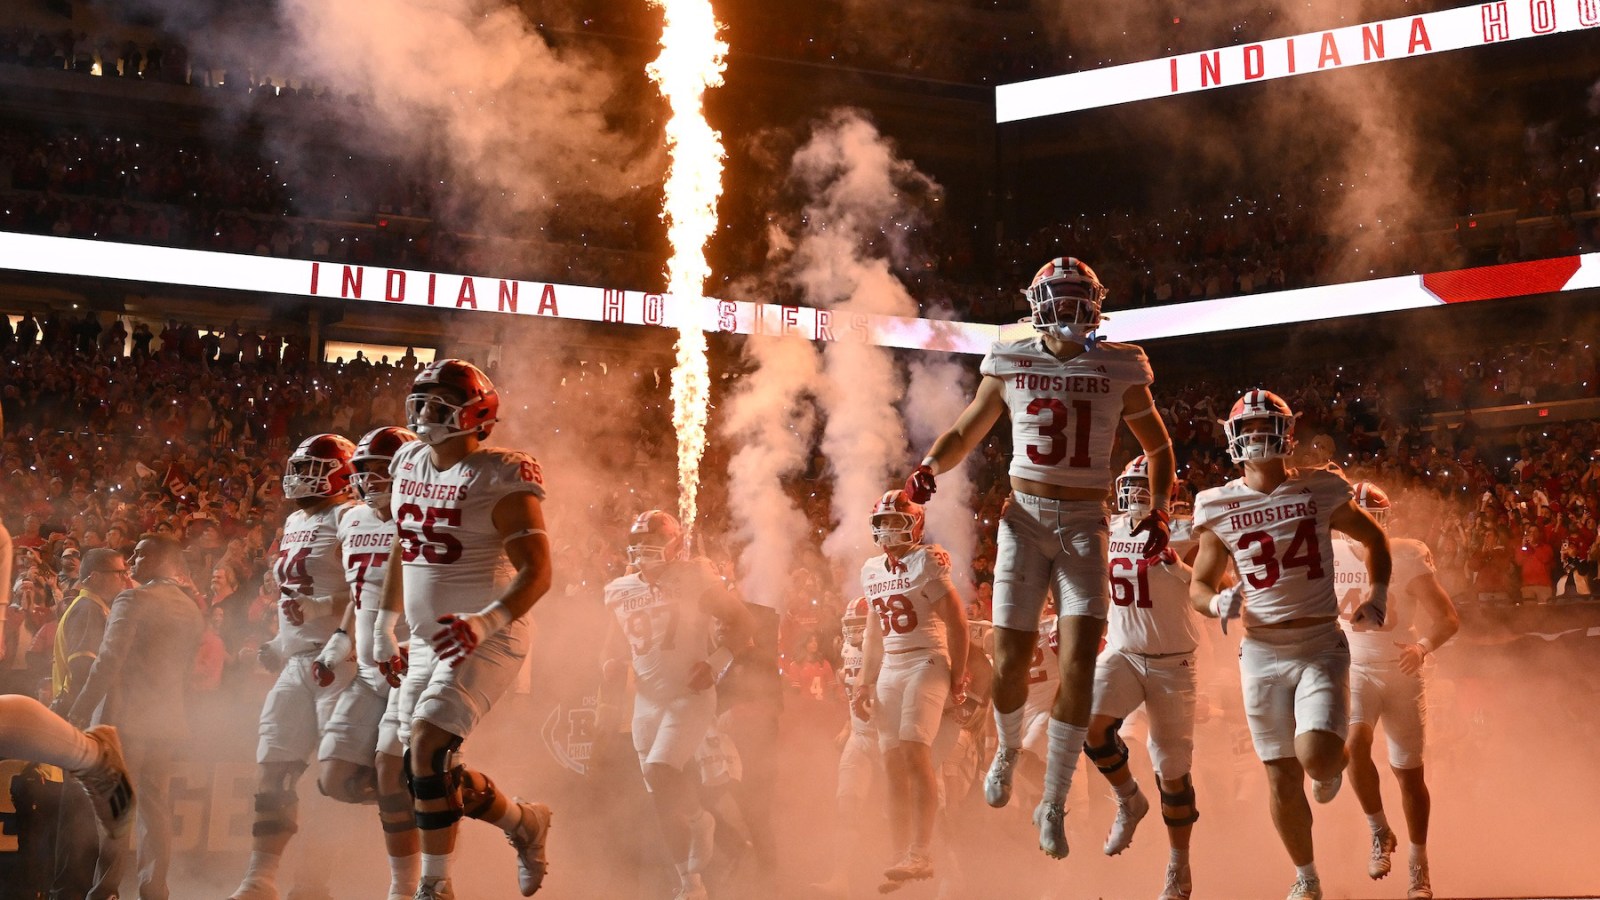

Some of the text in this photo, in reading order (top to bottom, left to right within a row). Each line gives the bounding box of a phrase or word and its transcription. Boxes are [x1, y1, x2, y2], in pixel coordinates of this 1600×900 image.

[1169, 17, 1432, 93] INDIANA
[310, 262, 869, 343] INDIANA HOSIERS
[1015, 373, 1111, 393] HOOSIERS
[1026, 397, 1092, 468] 31
[519, 460, 543, 485] 65
[399, 478, 468, 501] HOOSIERS
[1230, 500, 1318, 531] HOOSIERS
[350, 533, 394, 548] HOOSIE
[397, 503, 463, 564] 65
[1109, 541, 1145, 554] OOSIE
[1237, 518, 1325, 590] 34
[868, 577, 911, 597] HOOSIERS
[1108, 557, 1153, 609] 61
[628, 602, 680, 656] 97
[809, 676, 823, 700] 4
